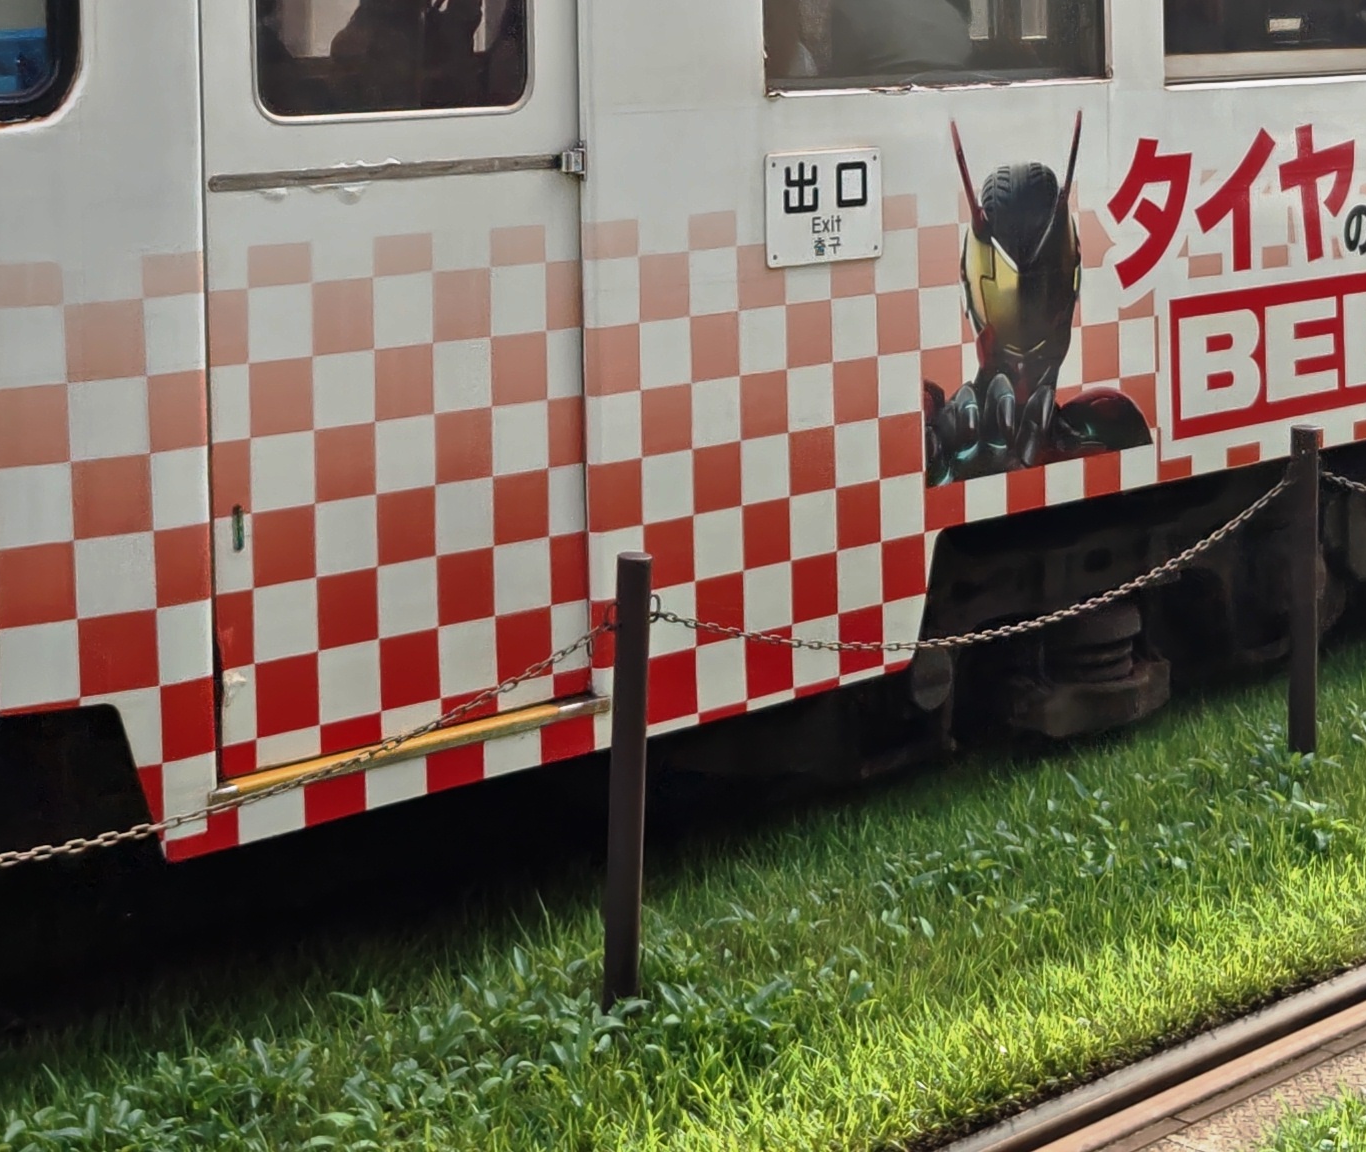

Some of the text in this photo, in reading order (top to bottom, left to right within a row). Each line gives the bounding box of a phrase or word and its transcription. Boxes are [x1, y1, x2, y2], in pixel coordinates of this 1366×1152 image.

[783, 160, 868, 214] 出口
[811, 214, 842, 234] Exit
[813, 236, 842, 256] 출구
